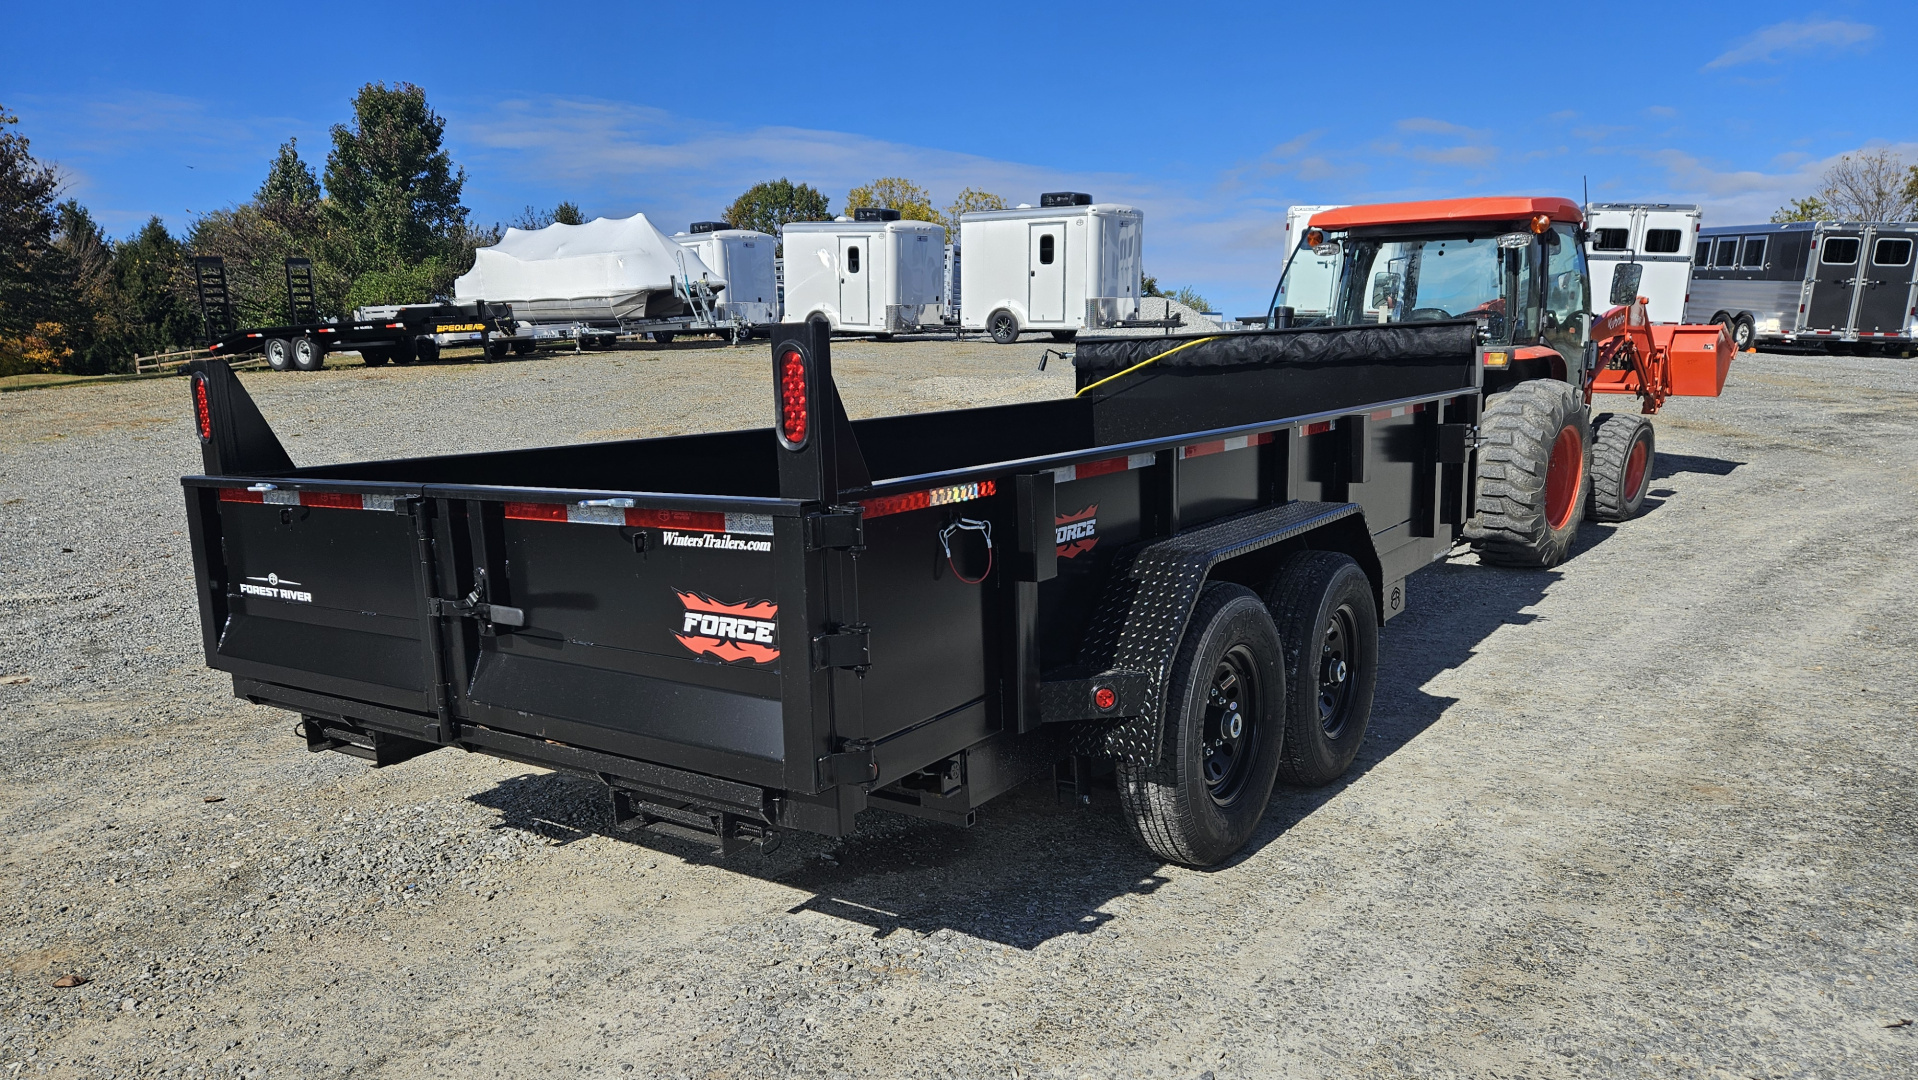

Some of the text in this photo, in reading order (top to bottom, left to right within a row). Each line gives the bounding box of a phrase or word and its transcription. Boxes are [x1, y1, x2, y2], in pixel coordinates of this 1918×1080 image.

[441, 323, 480, 333] PEQUEA
[662, 531, 771, 552] WintersTrailers.com
[1055, 518, 1097, 544] ORCE
[239, 583, 312, 602] FOREST RIVER
[683, 612, 776, 644] FORCE
